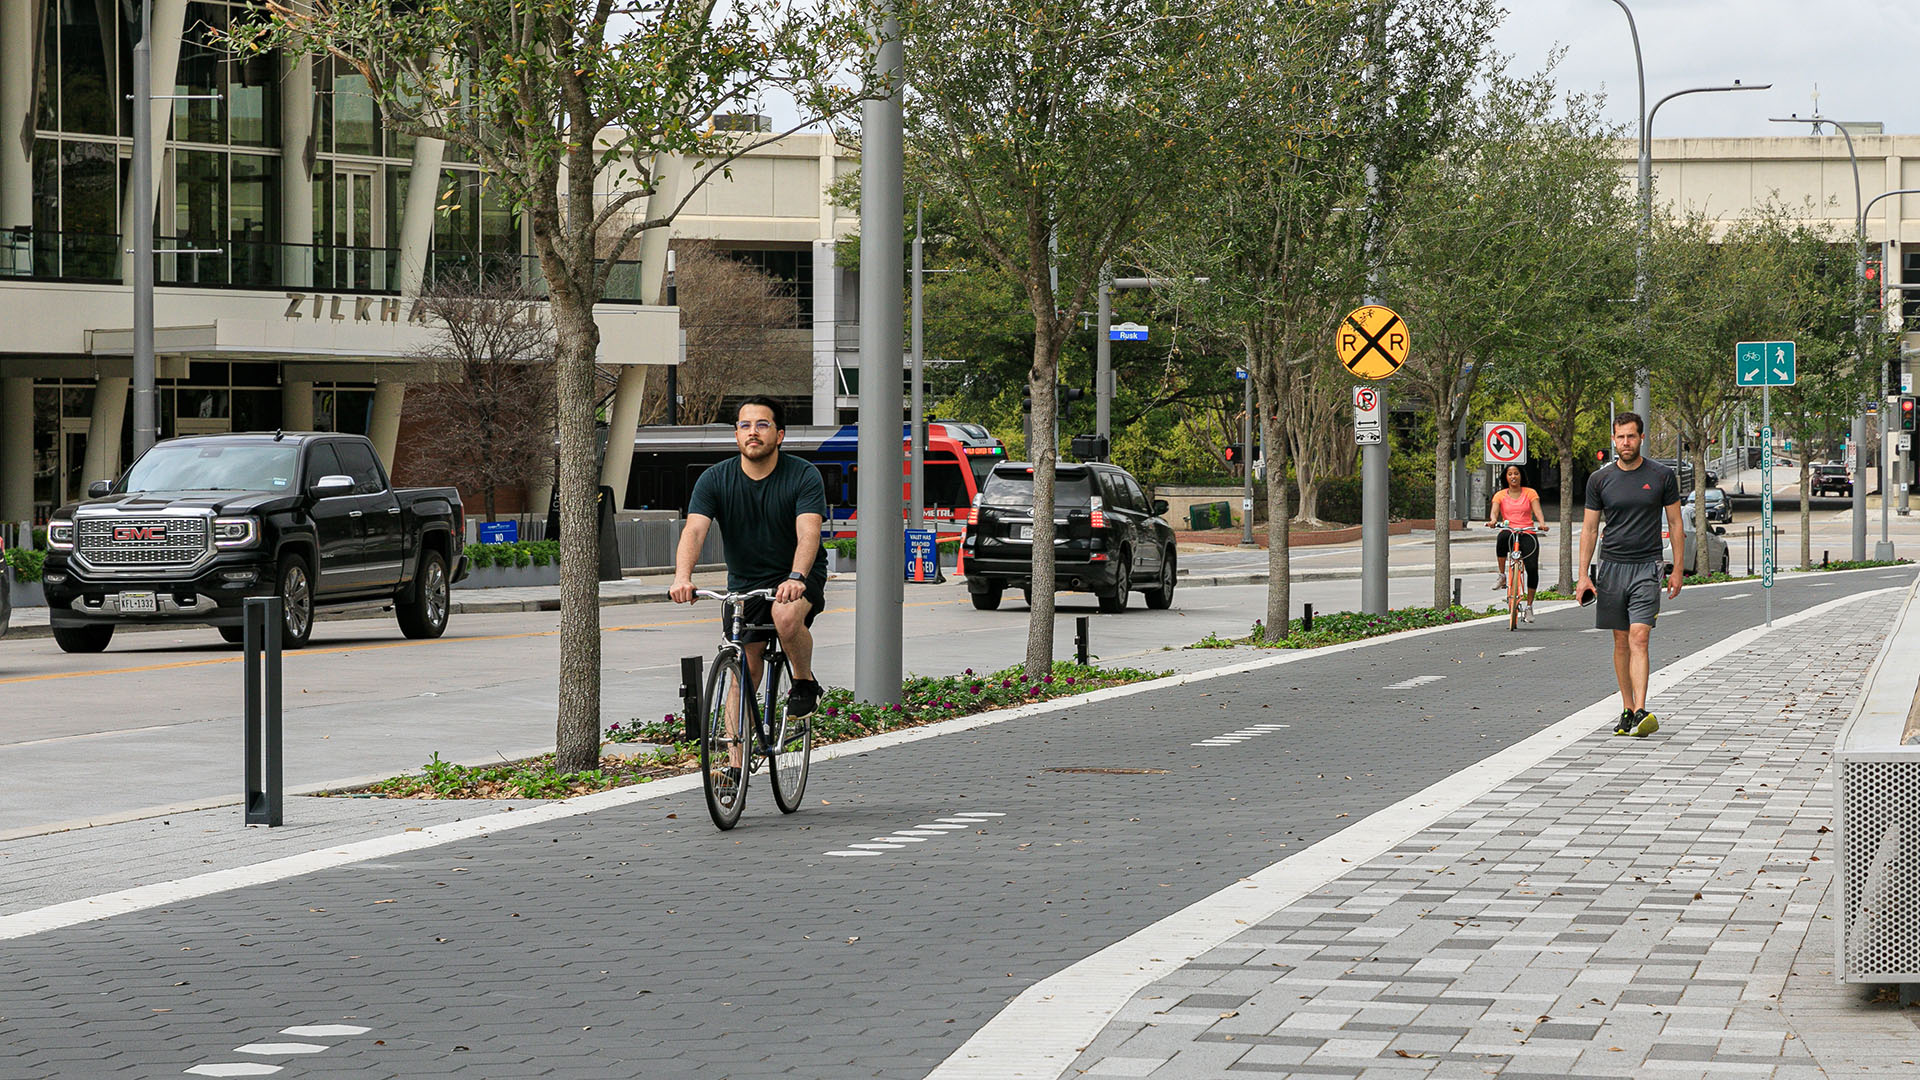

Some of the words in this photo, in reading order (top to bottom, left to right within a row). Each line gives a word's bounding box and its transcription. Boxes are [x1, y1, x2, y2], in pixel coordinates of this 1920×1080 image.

[284, 293, 427, 323] ZILKHA
[1120, 332, 1138, 340] Rusk
[1343, 334, 1356, 351] R
[1390, 333, 1404, 351] R
[113, 527, 166, 541] GMC
[495, 533, 504, 542] NO
[908, 561, 934, 573] CLSED
